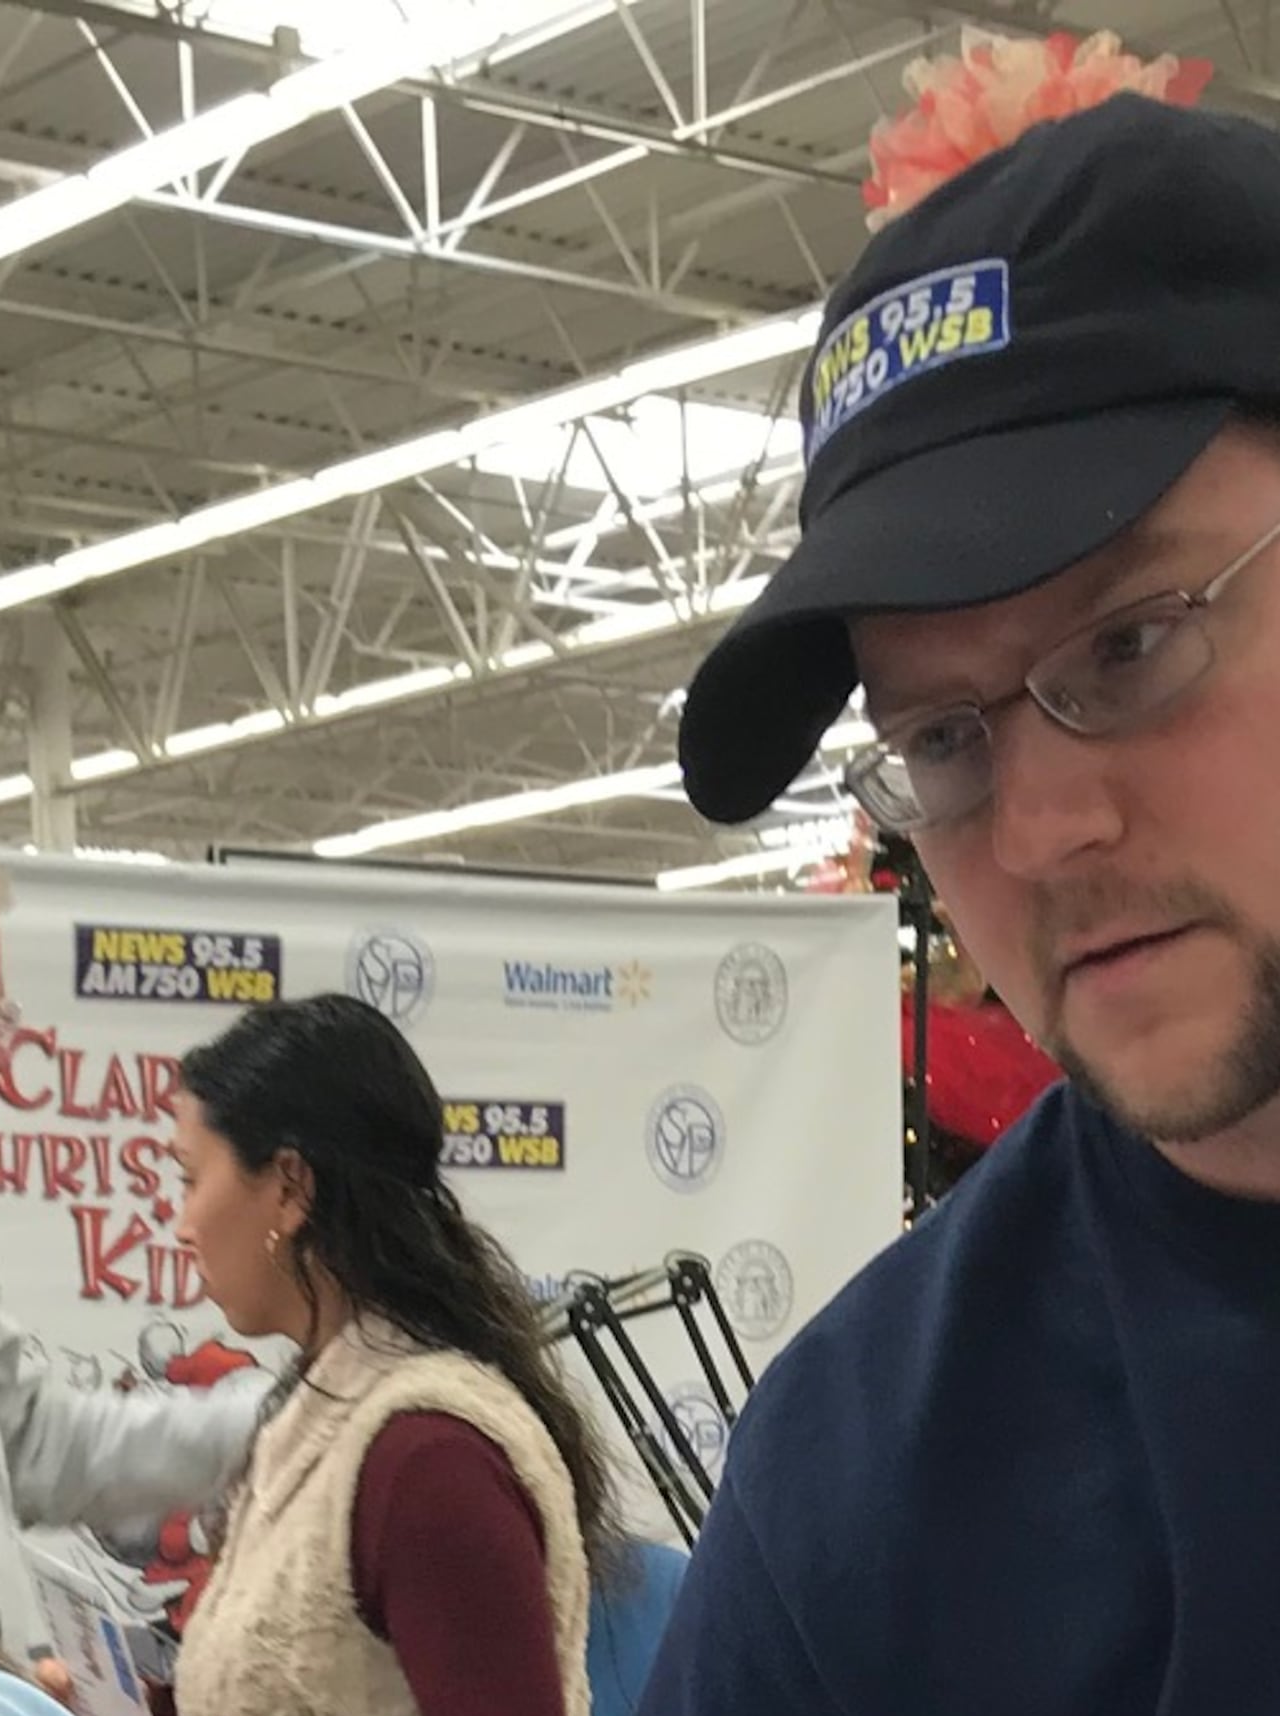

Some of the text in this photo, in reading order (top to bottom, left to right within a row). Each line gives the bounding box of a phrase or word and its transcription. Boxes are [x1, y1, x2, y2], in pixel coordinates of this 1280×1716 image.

[880, 275, 976, 344] 95.5
[899, 307, 992, 368] WSB
[93, 929, 264, 968] NEWS 95.5
[206, 967, 276, 1000] WSB
[504, 961, 613, 997] Walmart
[486, 1106, 549, 1136] 95.5
[497, 1136, 558, 1165] WSB
